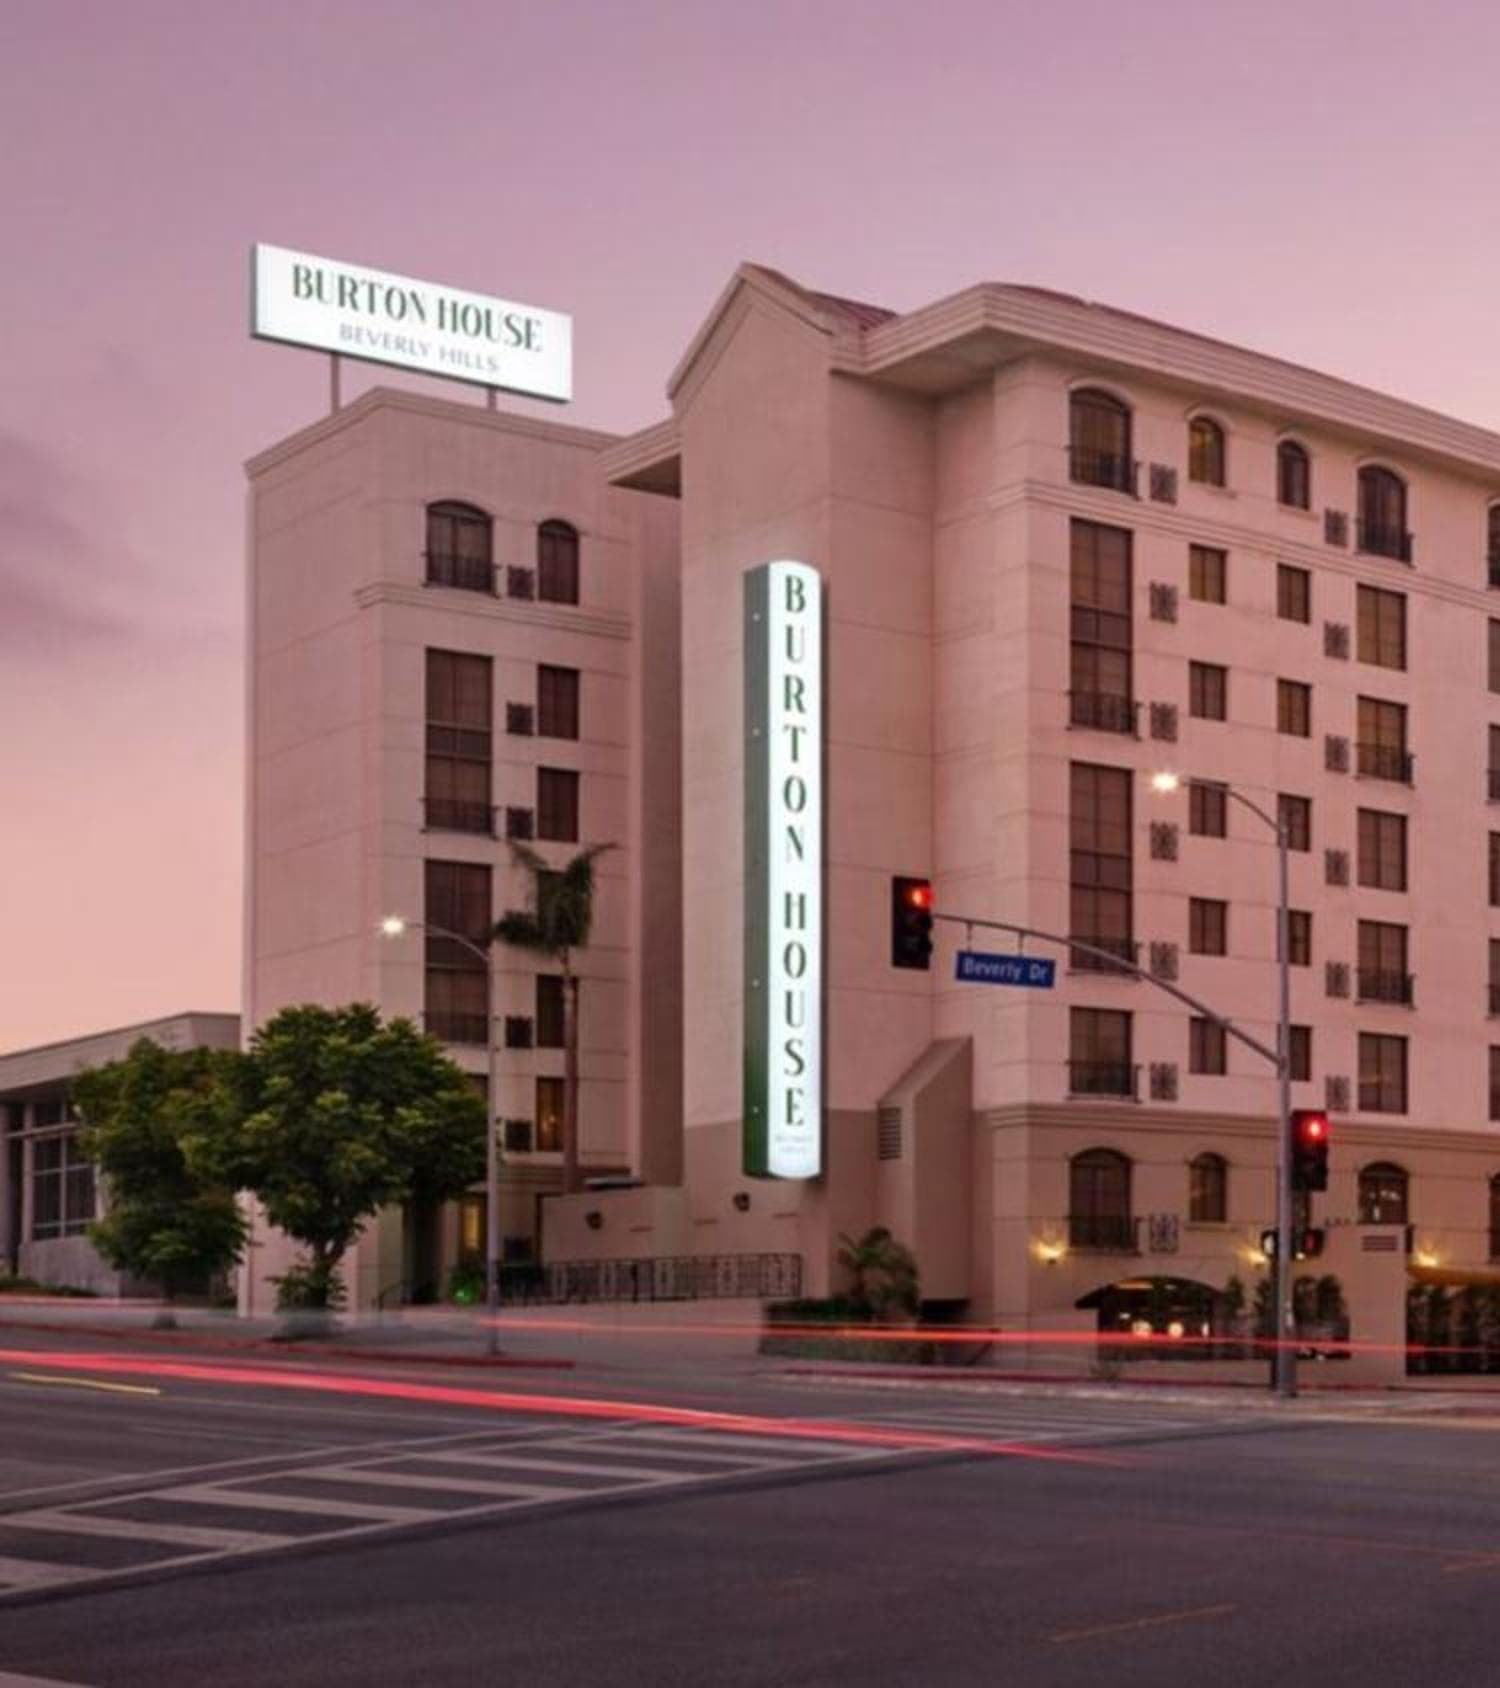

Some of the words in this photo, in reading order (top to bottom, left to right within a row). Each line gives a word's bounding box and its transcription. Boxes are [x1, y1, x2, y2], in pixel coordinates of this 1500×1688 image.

[293, 265, 427, 324] BURTON
[439, 298, 542, 352] HOUSE
[340, 324, 430, 357] BEVERLY
[439, 348, 499, 372] HILLS
[783, 575, 807, 862] BURTON
[783, 893, 806, 1126] HOUSE
[964, 957, 1021, 981] Beverly
